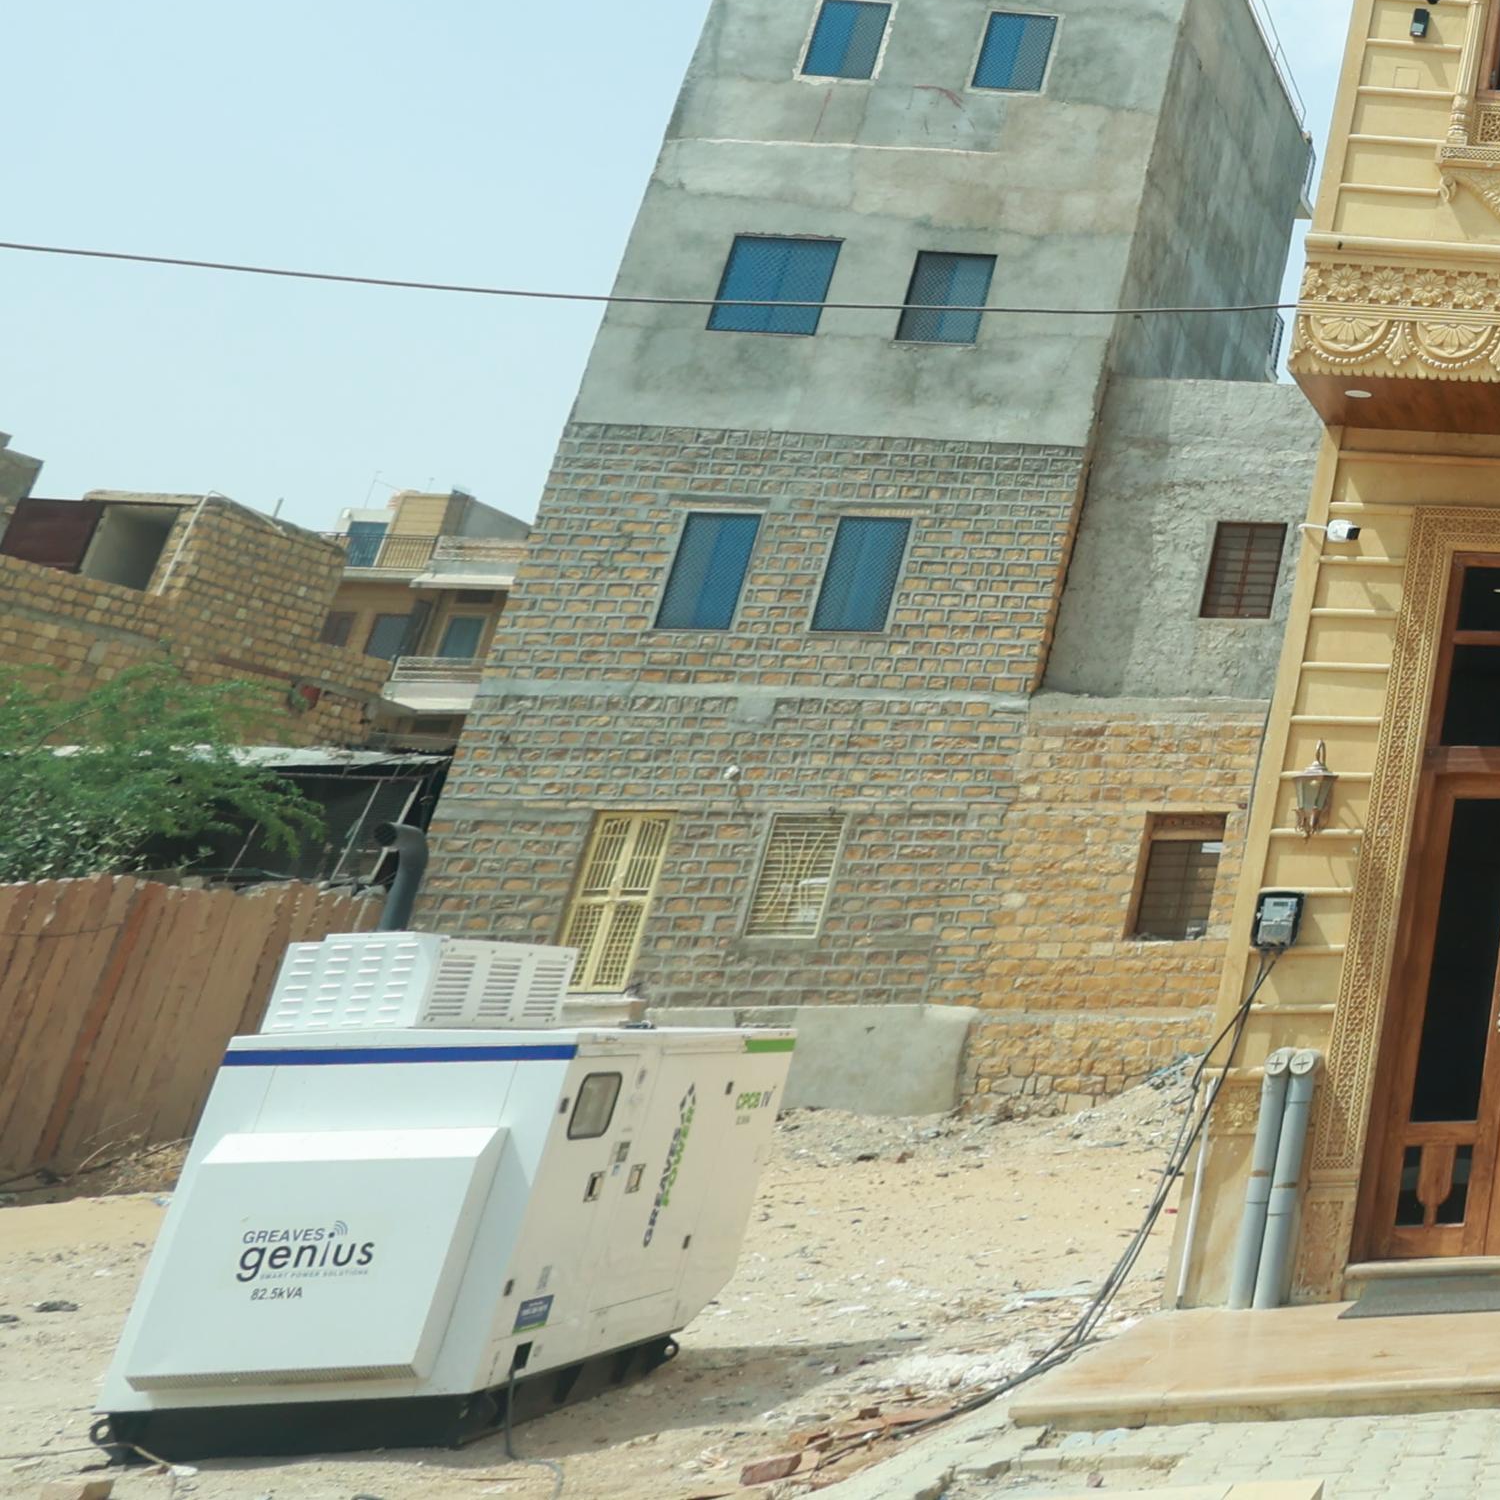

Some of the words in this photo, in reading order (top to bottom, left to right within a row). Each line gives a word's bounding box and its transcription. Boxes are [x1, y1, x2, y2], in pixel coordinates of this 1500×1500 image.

[243, 1228, 325, 1244] GREAVES
[236, 1232, 375, 1282] genius
[250, 1287, 303, 1301] 82.5kVA
